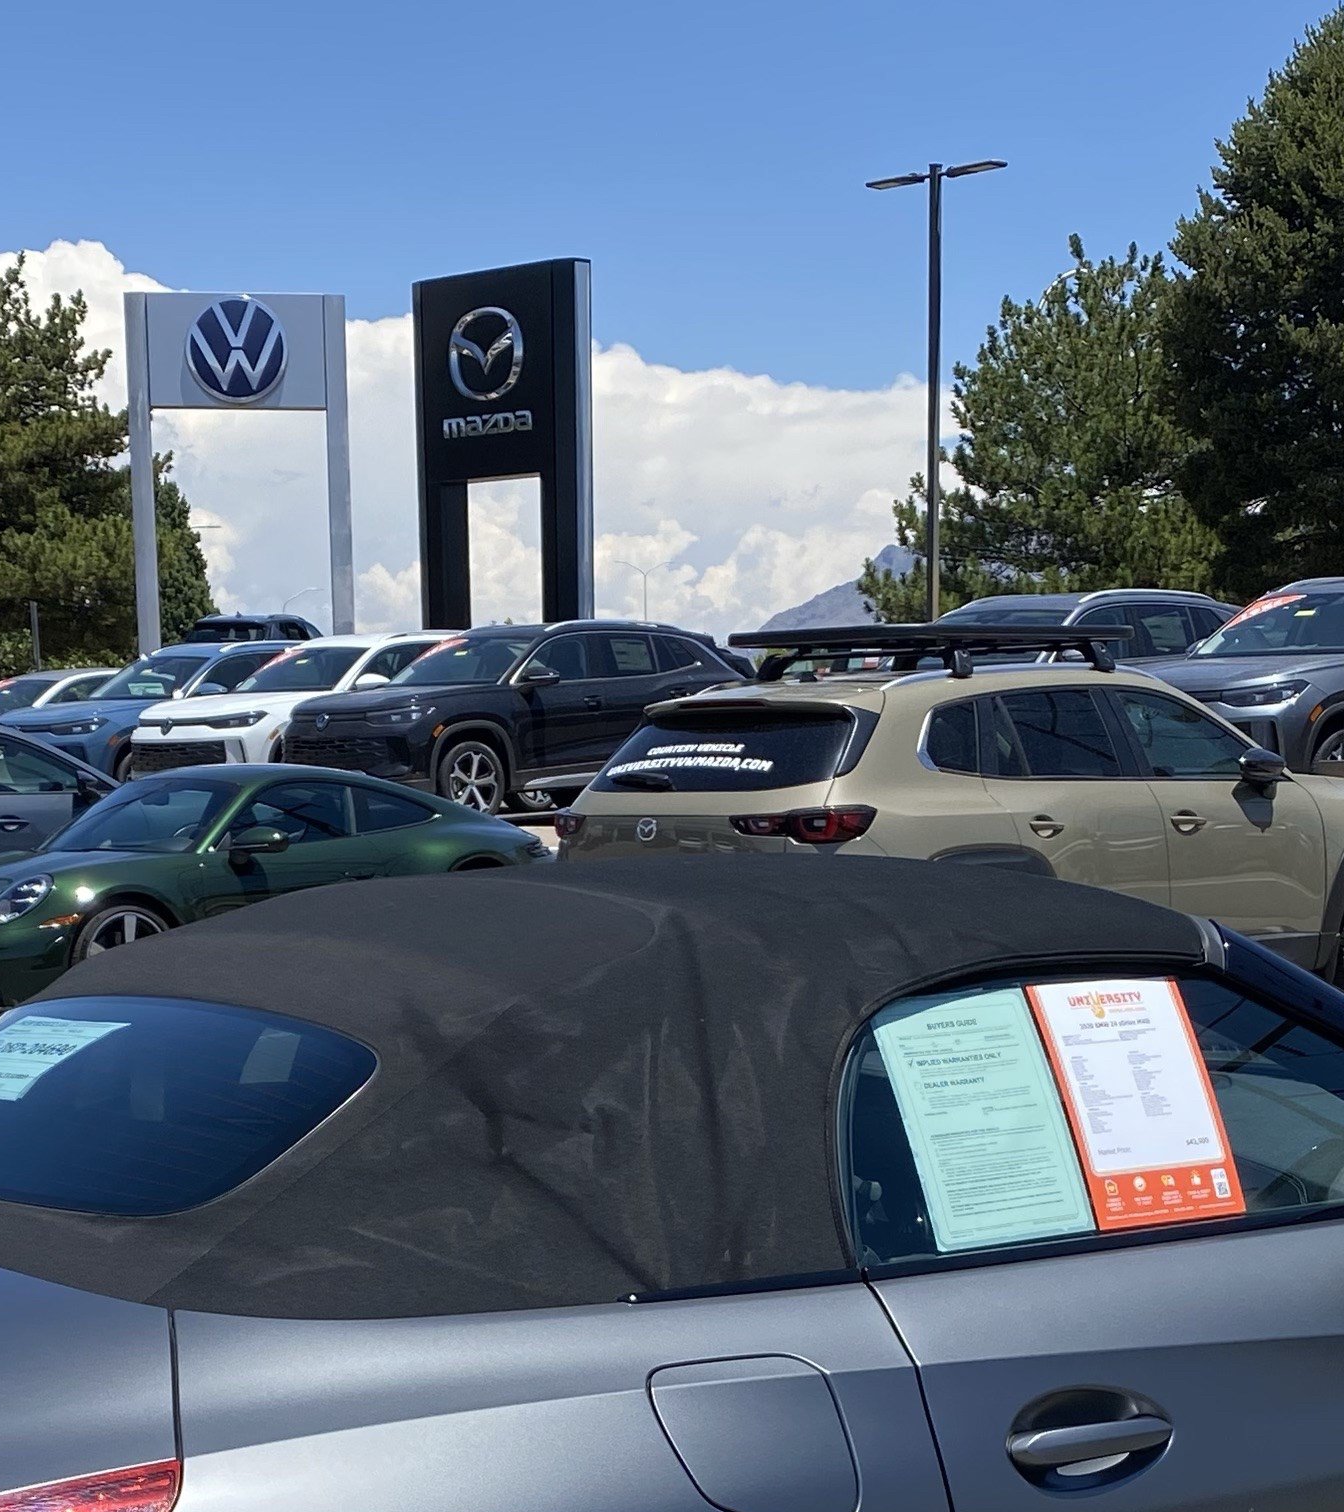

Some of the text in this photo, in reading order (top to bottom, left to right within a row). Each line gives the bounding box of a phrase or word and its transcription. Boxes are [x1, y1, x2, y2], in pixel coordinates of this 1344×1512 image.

[188, 296, 287, 404] VW
[697, 743, 746, 753] VEHICLE
[956, 1018, 978, 1027] GUIDE
